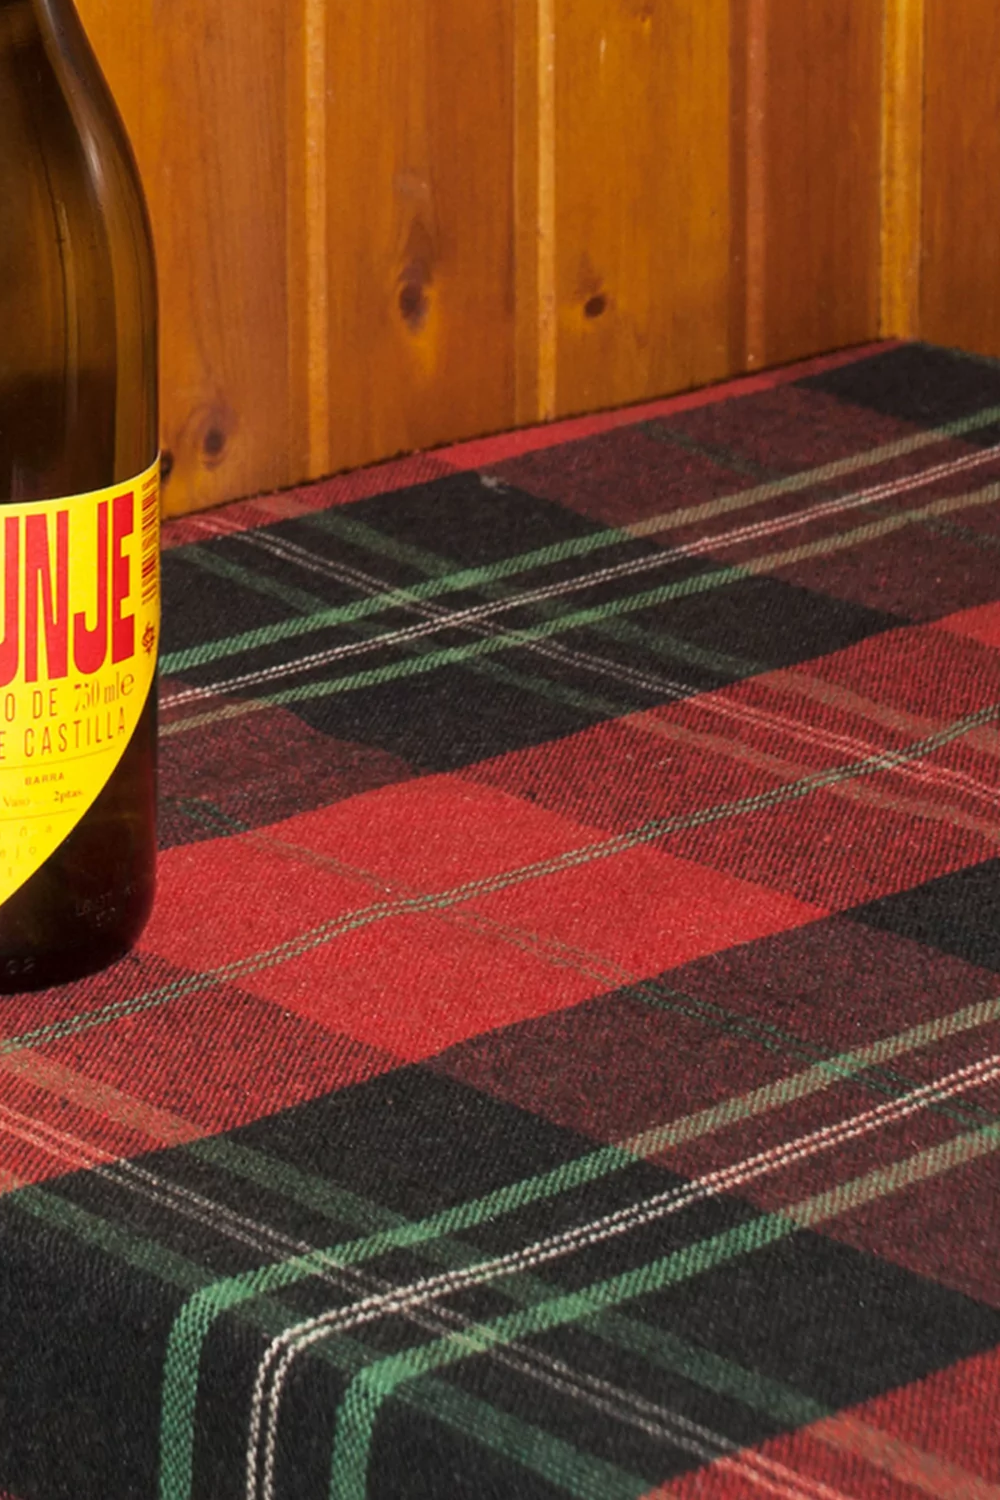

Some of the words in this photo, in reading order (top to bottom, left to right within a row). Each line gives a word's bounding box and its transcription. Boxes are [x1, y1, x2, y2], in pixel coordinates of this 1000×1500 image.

[32, 687, 58, 719] DE
[23, 705, 127, 758] CASTILLA
[24, 771, 66, 787] BARRA
